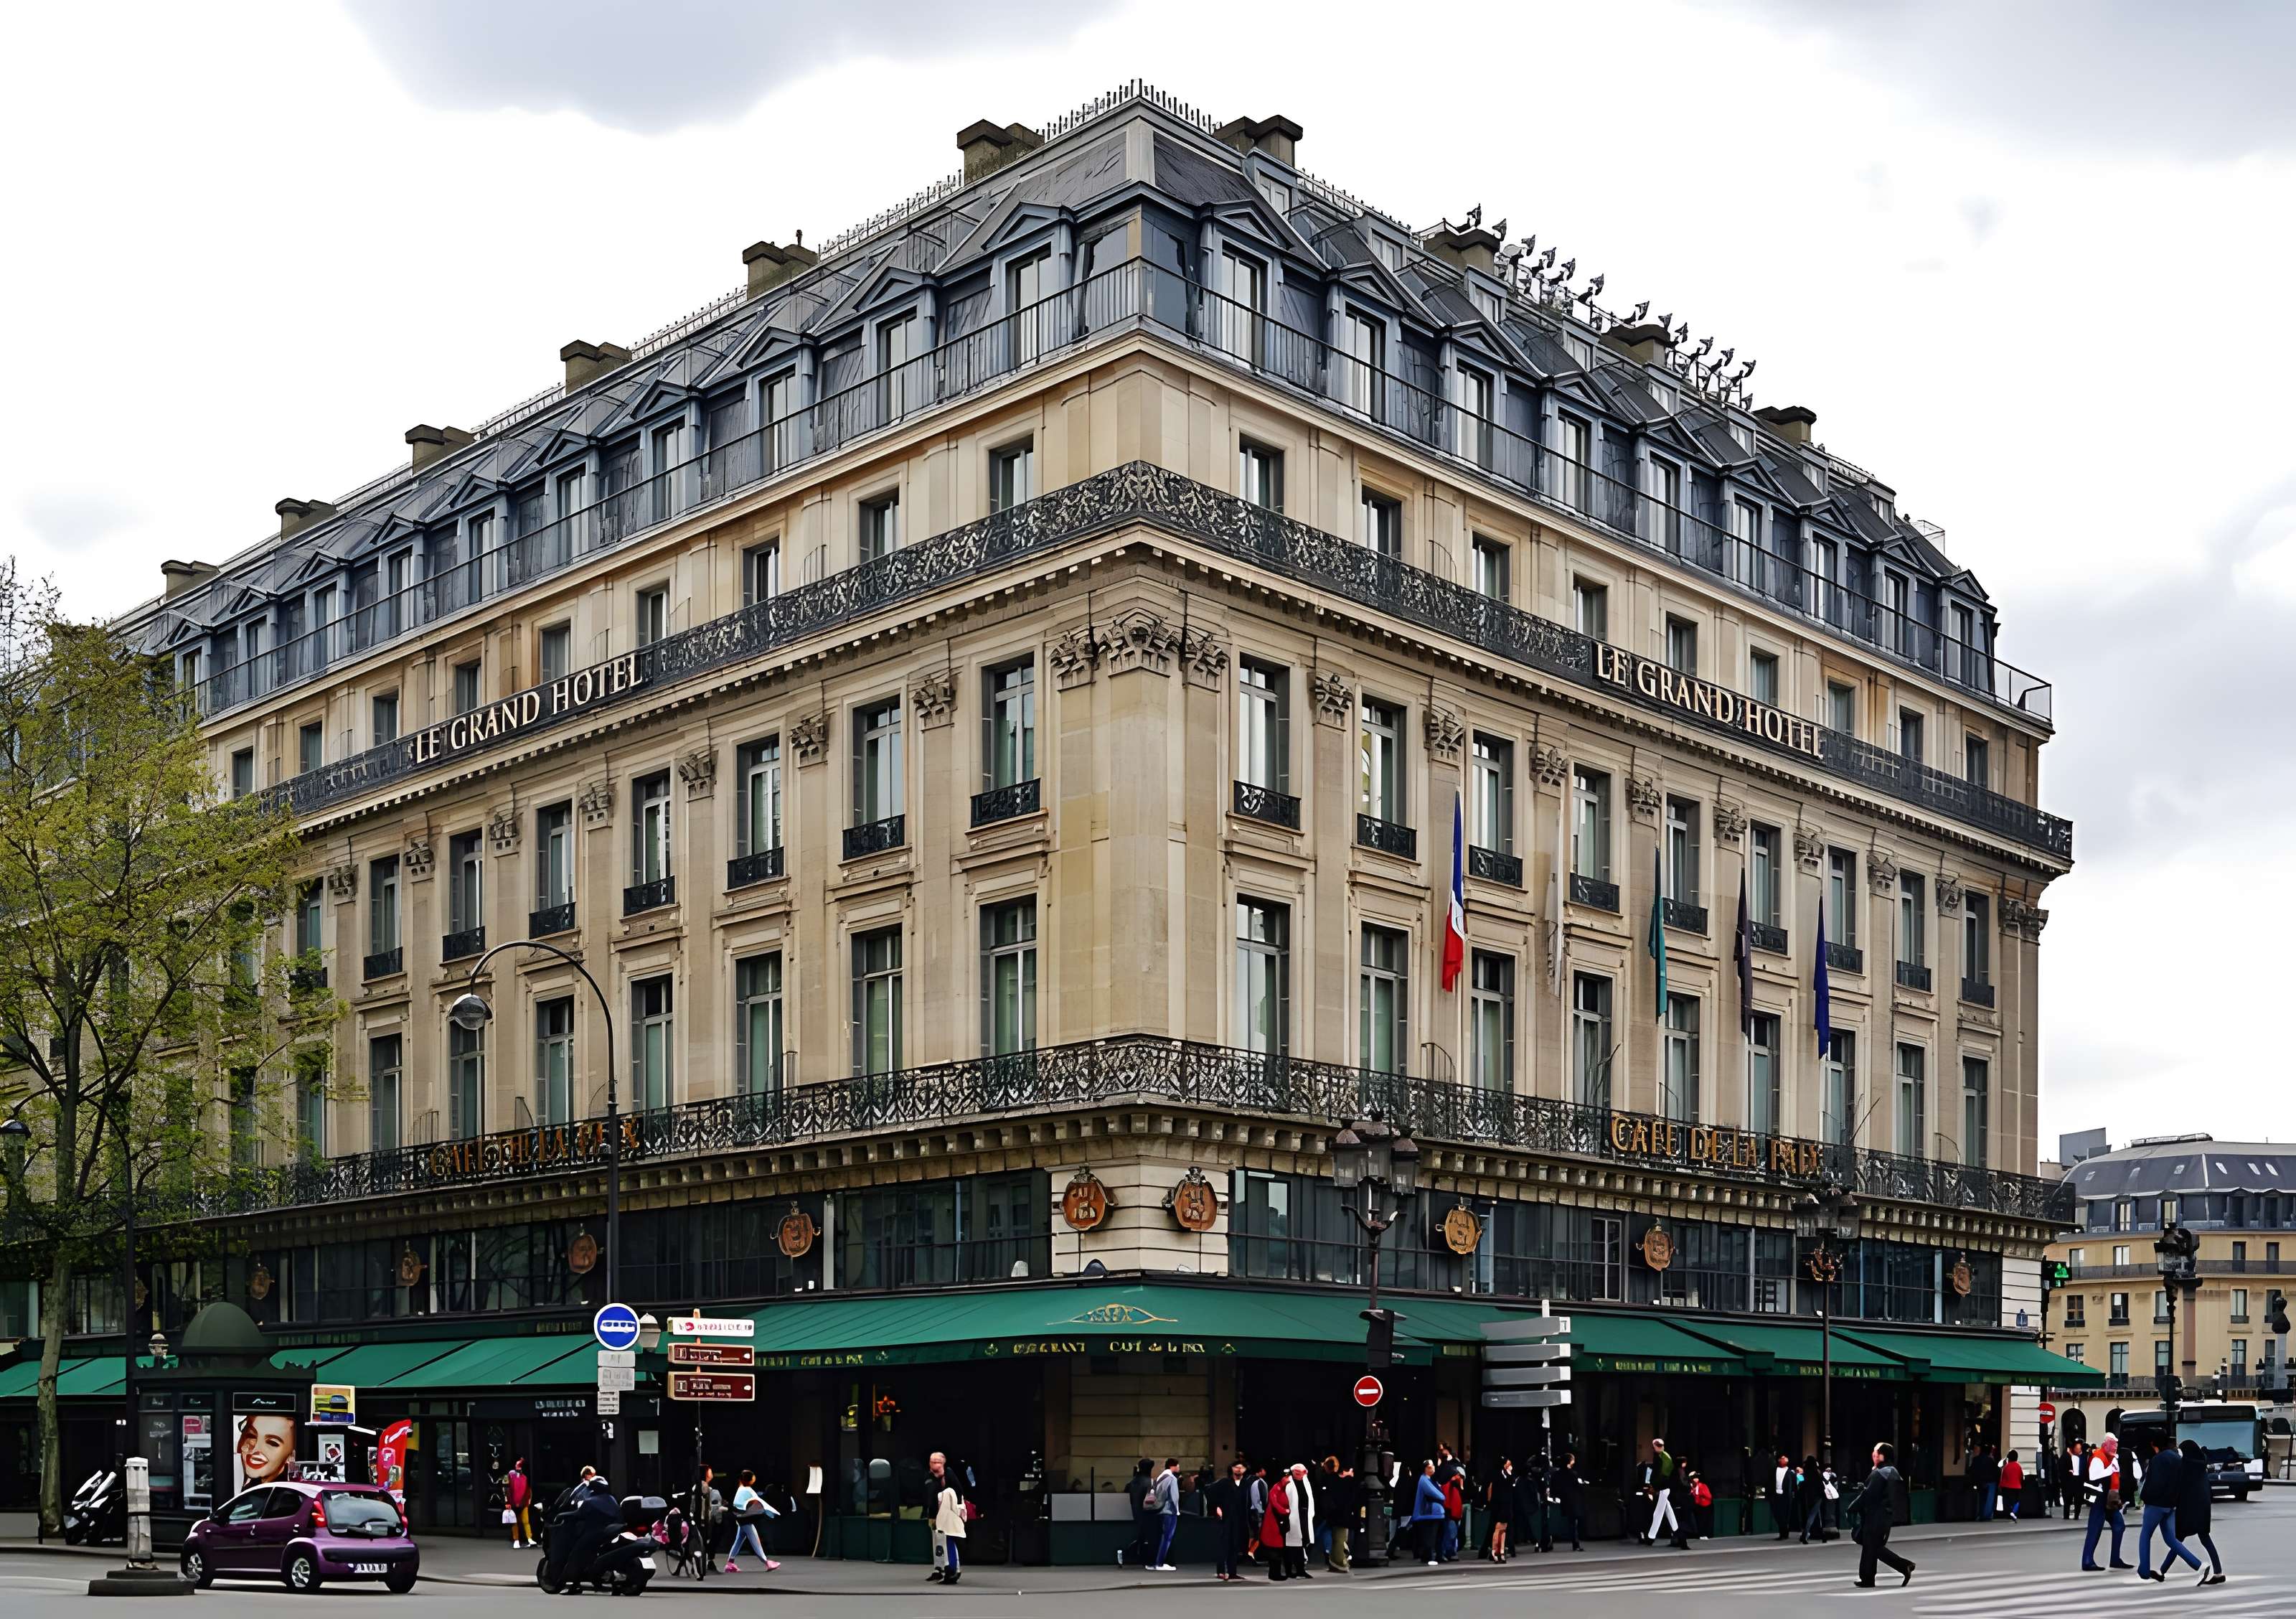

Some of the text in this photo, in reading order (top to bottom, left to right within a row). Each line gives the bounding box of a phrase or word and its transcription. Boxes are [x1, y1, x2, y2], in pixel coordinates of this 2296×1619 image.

[416, 652, 643, 764] LE GRAND HOTEL
[1597, 644, 1824, 760] LE GRAND HOTEL
